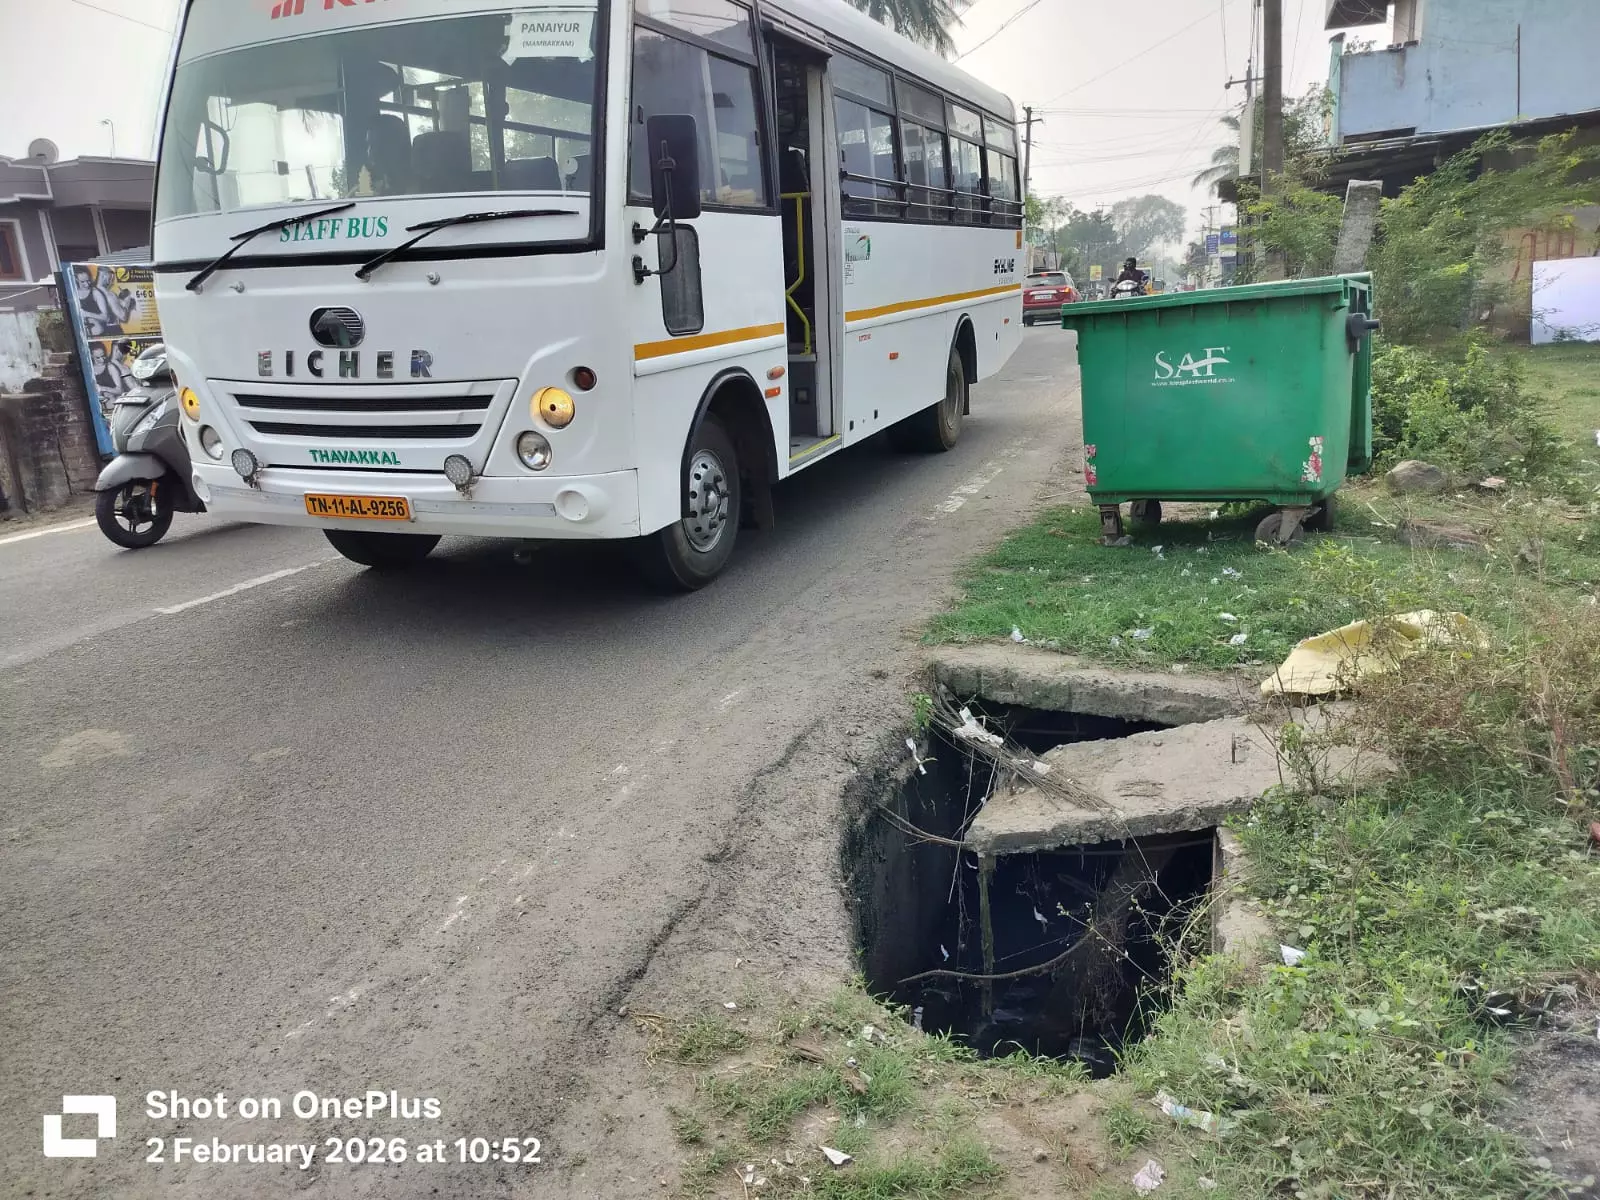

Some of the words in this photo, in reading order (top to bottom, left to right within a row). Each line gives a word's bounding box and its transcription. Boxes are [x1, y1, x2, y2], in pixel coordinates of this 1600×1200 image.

[521, 22, 580, 33] PANAIYUR
[280, 218, 343, 242] STAFF
[346, 215, 389, 239] BUS
[258, 350, 434, 378] EICHER
[1154, 346, 1230, 380] SAF
[309, 449, 401, 465] THAVAKKAL
[308, 497, 405, 517] TN-11-AL-9256
